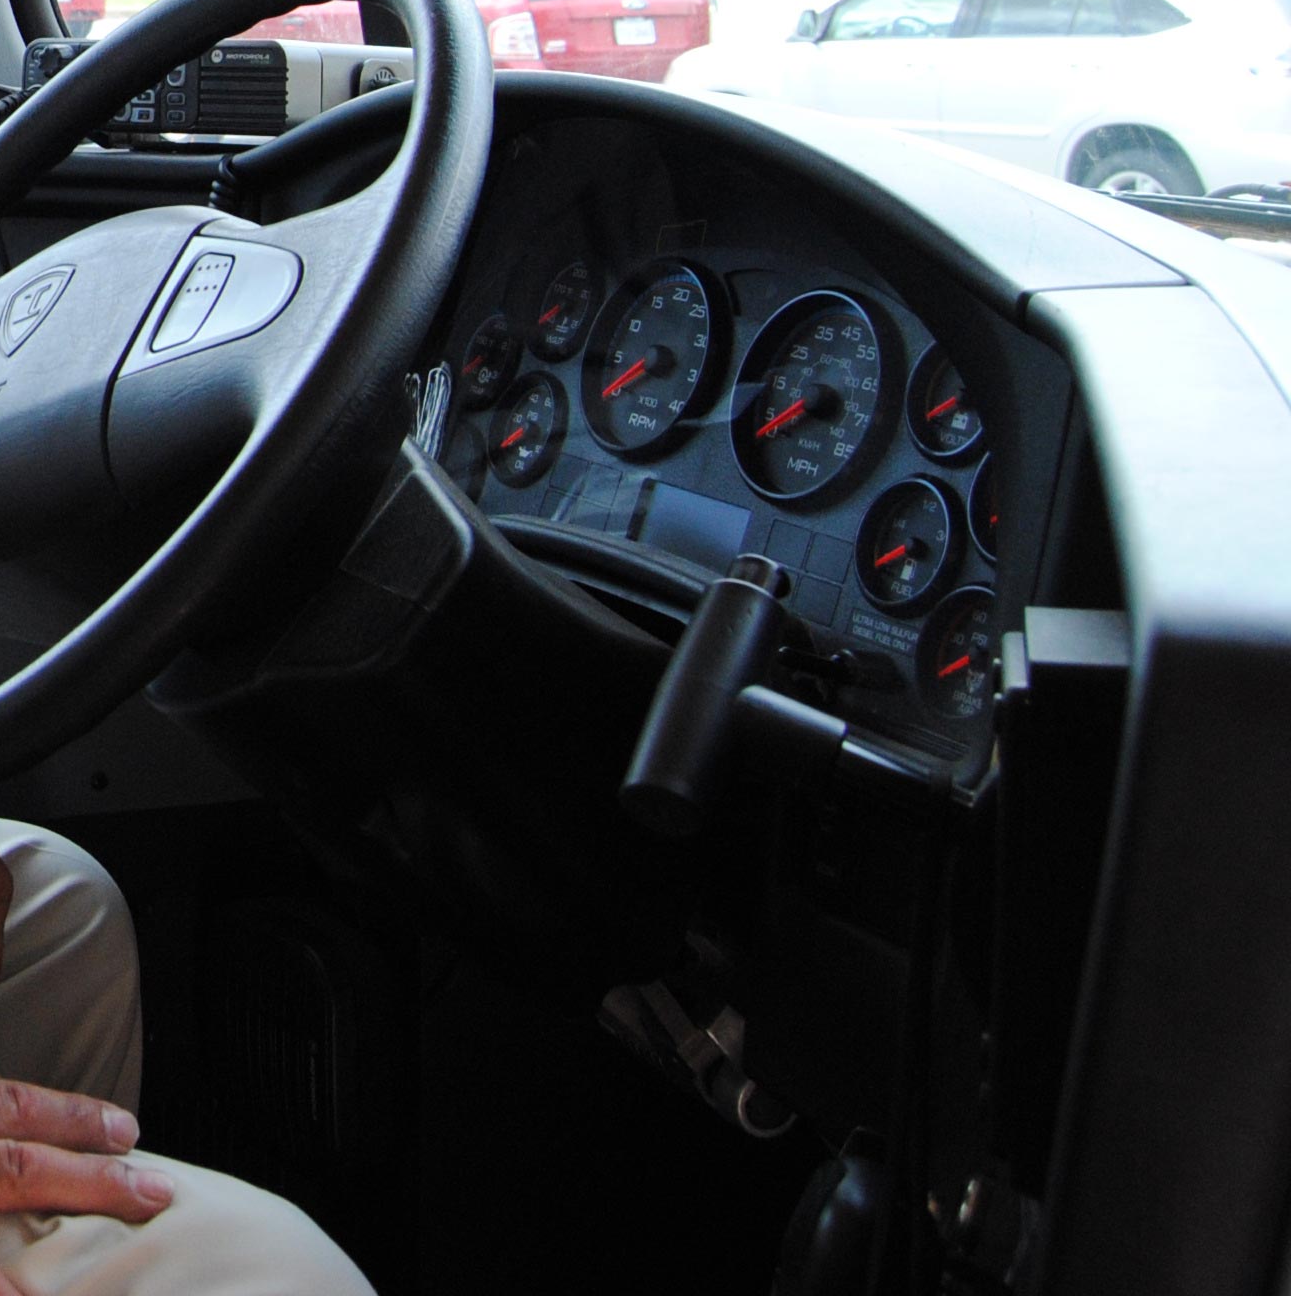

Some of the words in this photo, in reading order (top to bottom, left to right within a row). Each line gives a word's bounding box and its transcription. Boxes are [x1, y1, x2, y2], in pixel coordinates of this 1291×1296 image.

[651, 296, 664, 309] 15
[672, 288, 690, 302] 20
[688, 303, 706, 318] 25
[628, 319, 641, 332] 10
[814, 325, 834, 341] 35
[840, 325, 862, 341] 45
[614, 350, 623, 364] 5
[790, 344, 809, 360] 25
[856, 344, 876, 360] 55
[772, 375, 786, 390] 15
[789, 387, 801, 398] 20
[668, 399, 685, 414] 40
[764, 407, 775, 422] 5
[843, 400, 859, 413] 120
[628, 412, 656, 431] RPM
[833, 442, 856, 459] 85
[786, 456, 819, 477] MPH
[890, 580, 915, 598] FUEL
[852, 612, 875, 627] ULTRA
[875, 620, 891, 633] LOW
[852, 624, 874, 639] DIESEL
[875, 632, 892, 646] FUEL
[892, 638, 910, 652] ONLY
[971, 631, 988, 647] PSI
[953, 689, 983, 710] BRAKE
